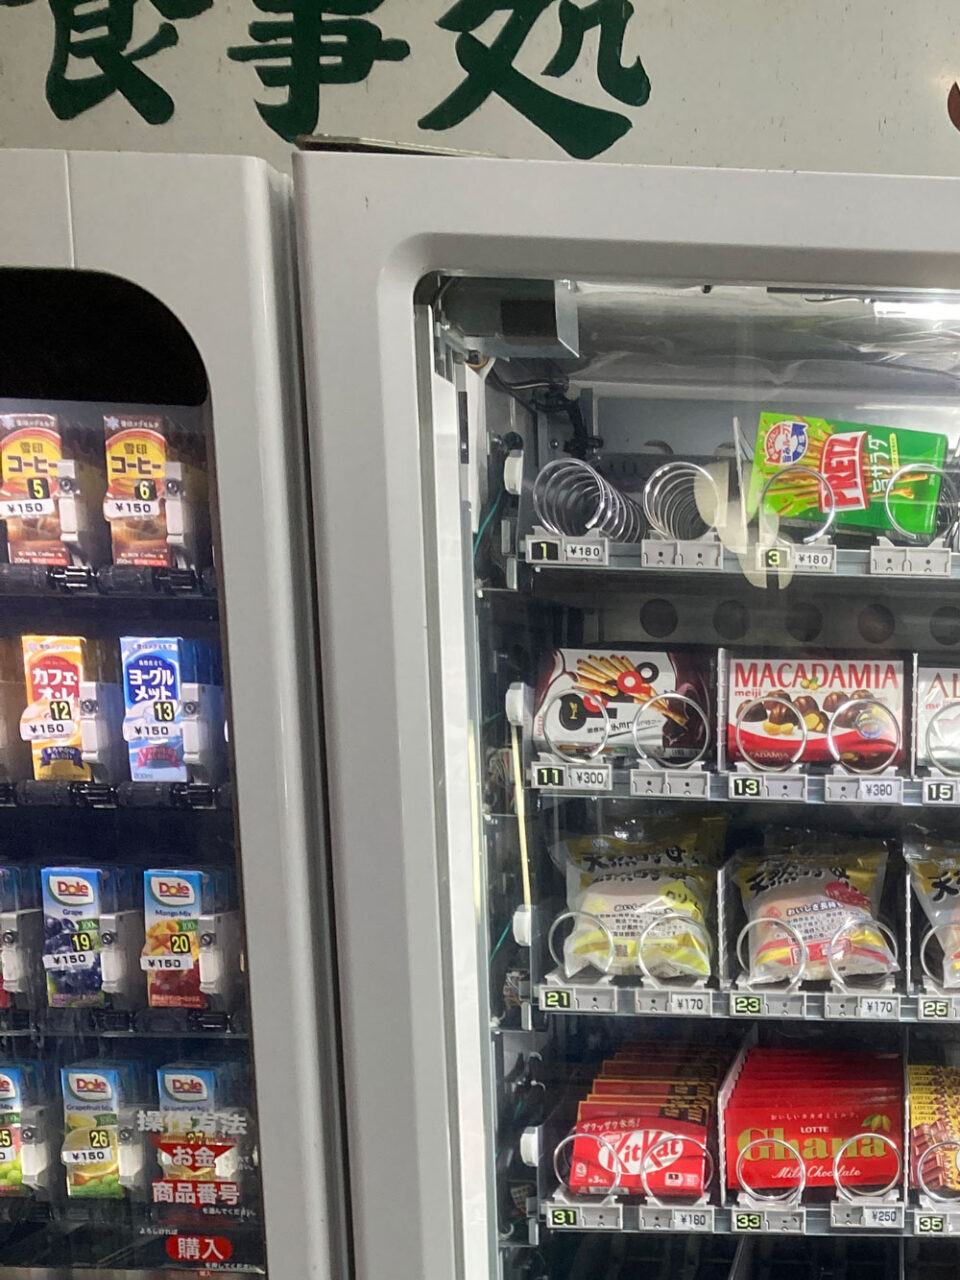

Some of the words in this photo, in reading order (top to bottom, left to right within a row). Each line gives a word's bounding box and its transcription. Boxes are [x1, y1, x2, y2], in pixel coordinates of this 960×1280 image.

[124, 443, 147, 454] 雪印
[8, 456, 58, 475] コーヒー
[111, 456, 161, 475] コーヒー
[869, 435, 894, 493] 旨サラダ
[823, 437, 863, 508] PRETZ
[33, 480, 43, 498] 5
[139, 481, 149, 499] 6
[8, 504, 43, 513] ¥150
[116, 503, 151, 513] ¥150
[540, 544, 547, 558] 1
[570, 546, 600, 557] ¥180
[768, 552, 780, 565] 3
[799, 554, 828, 565] ¥180
[129, 669, 174, 686] ヨーグル
[735, 663, 898, 689] MACADAMIA
[135, 688, 172, 701] メット
[52, 703, 69, 719] 12
[155, 704, 173, 720] 13
[30, 724, 64, 733] ¥150
[135, 726, 169, 735] ¥150
[540, 769, 559, 783] 11
[577, 773, 604, 784] ¥300
[735, 780, 758, 794] 13
[866, 785, 892, 795] ¥380
[928, 785, 952, 798] 15
[58, 881, 89, 895] Dole
[159, 882, 190, 895] Dole
[63, 908, 83, 917] Grape
[73, 935, 90, 950] 19
[171, 936, 189, 953] 20
[53, 954, 86, 964] ¥150
[148, 959, 181, 968] ¥150
[547, 992, 569, 1005] 21
[677, 999, 703, 1010] ¥170
[736, 998, 759, 1011] 23
[867, 1002, 892, 1013] ¥170
[925, 1003, 947, 1015] 25
[77, 1078, 106, 1090] Dole
[173, 1079, 202, 1091] Dole
[137, 1110, 247, 1136] 操作方法
[801, 1126, 828, 1134] LOTTE
[91, 1131, 107, 1147] 26
[737, 1127, 886, 1162] Ghana
[73, 1151, 104, 1161] ¥150
[173, 1146, 217, 1169] お金
[607, 1131, 680, 1173] KitKat
[152, 1182, 240, 1205] 商品番号
[554, 1212, 576, 1223] 31
[681, 1215, 706, 1224] ¥180
[737, 1215, 760, 1227] 33
[872, 1212, 896, 1222] ¥250
[920, 1219, 943, 1230] 35
[178, 1238, 224, 1260] 購入
